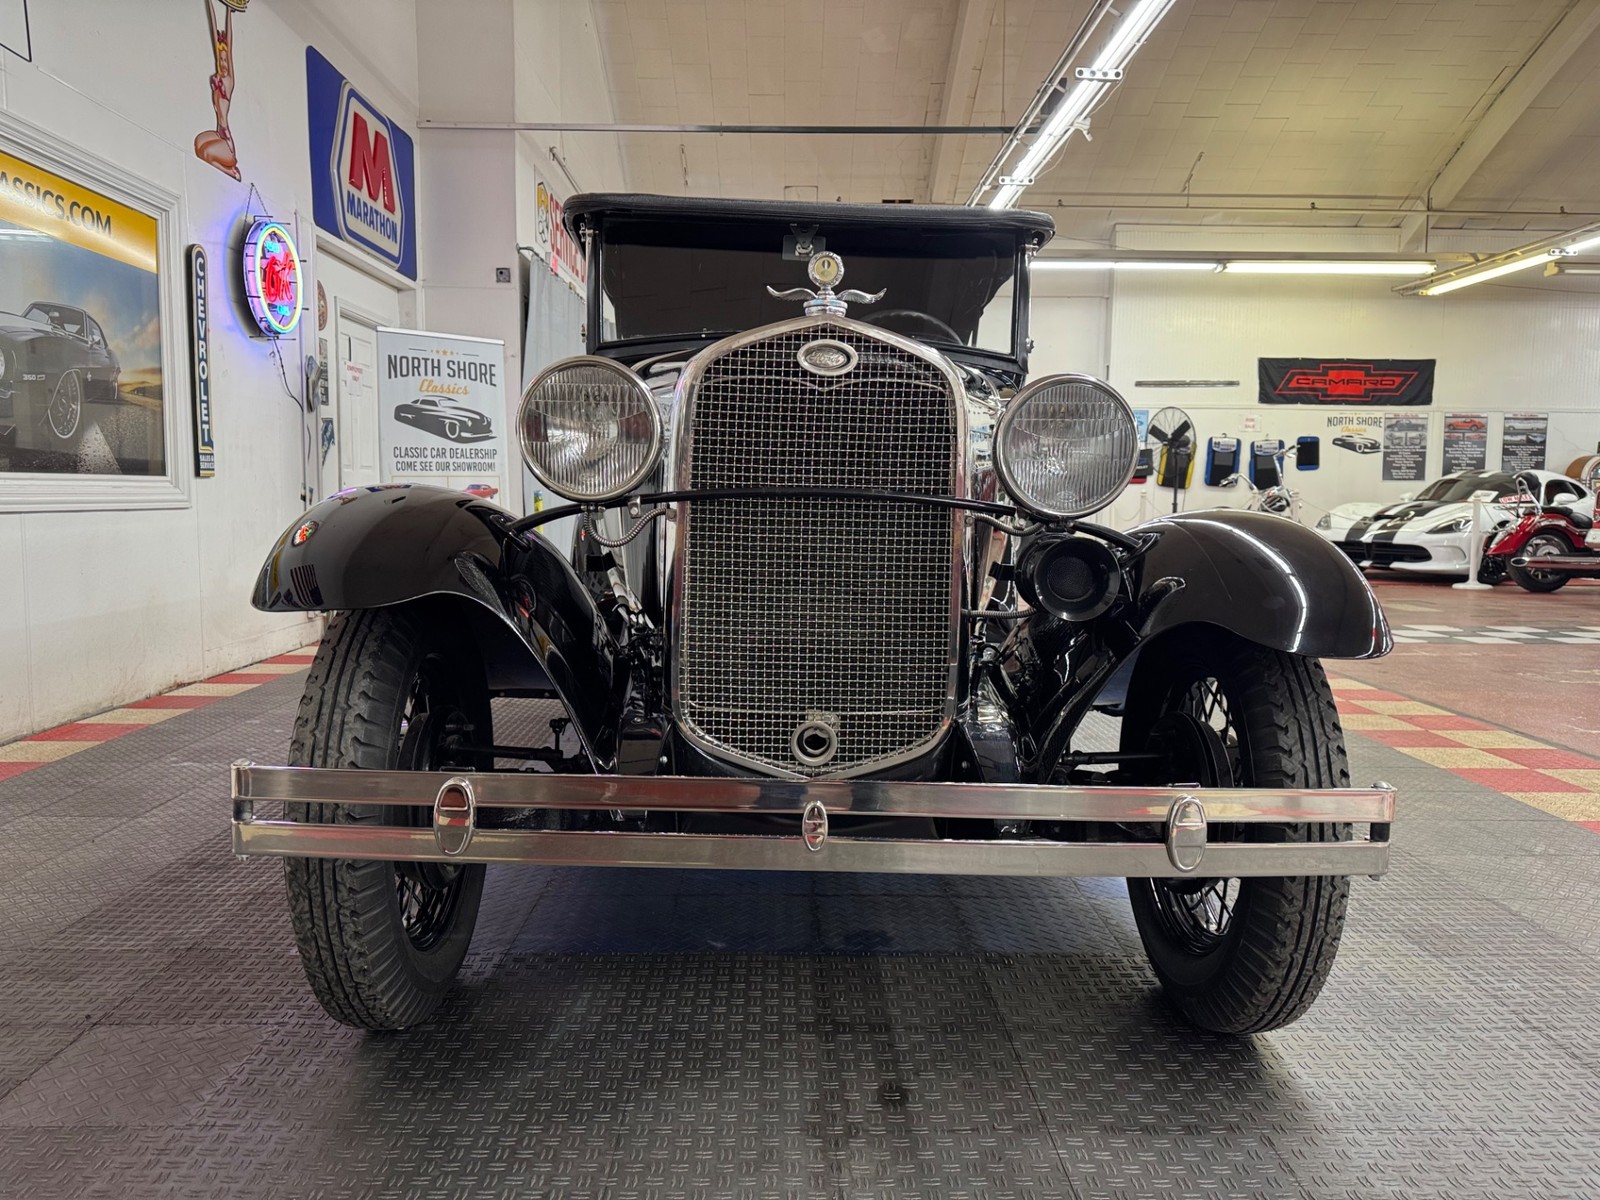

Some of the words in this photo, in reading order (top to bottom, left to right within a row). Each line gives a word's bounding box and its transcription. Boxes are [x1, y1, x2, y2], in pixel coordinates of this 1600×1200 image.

[348, 111, 395, 215] M
[0, 171, 111, 238] ASSICS.COM
[346, 190, 398, 244] MARATHON
[196, 258, 209, 441] CHEVROLET
[387, 354, 441, 379] NORTH
[446, 359, 497, 387] SHORE
[1296, 377, 1395, 386] CAMARO
[418, 378, 470, 395] Classics
[1326, 416, 1354, 427] NORTH
[1356, 416, 1383, 428] SHORE
[393, 447, 428, 459] CLASSIC
[430, 447, 447, 459] CAR
[449, 448, 498, 460] DEALERSHIP
[395, 461, 418, 472] COME
[420, 461, 433, 472] SEE
[435, 461, 450, 472] OUR
[452, 462, 496, 472] SHOWROOM!
